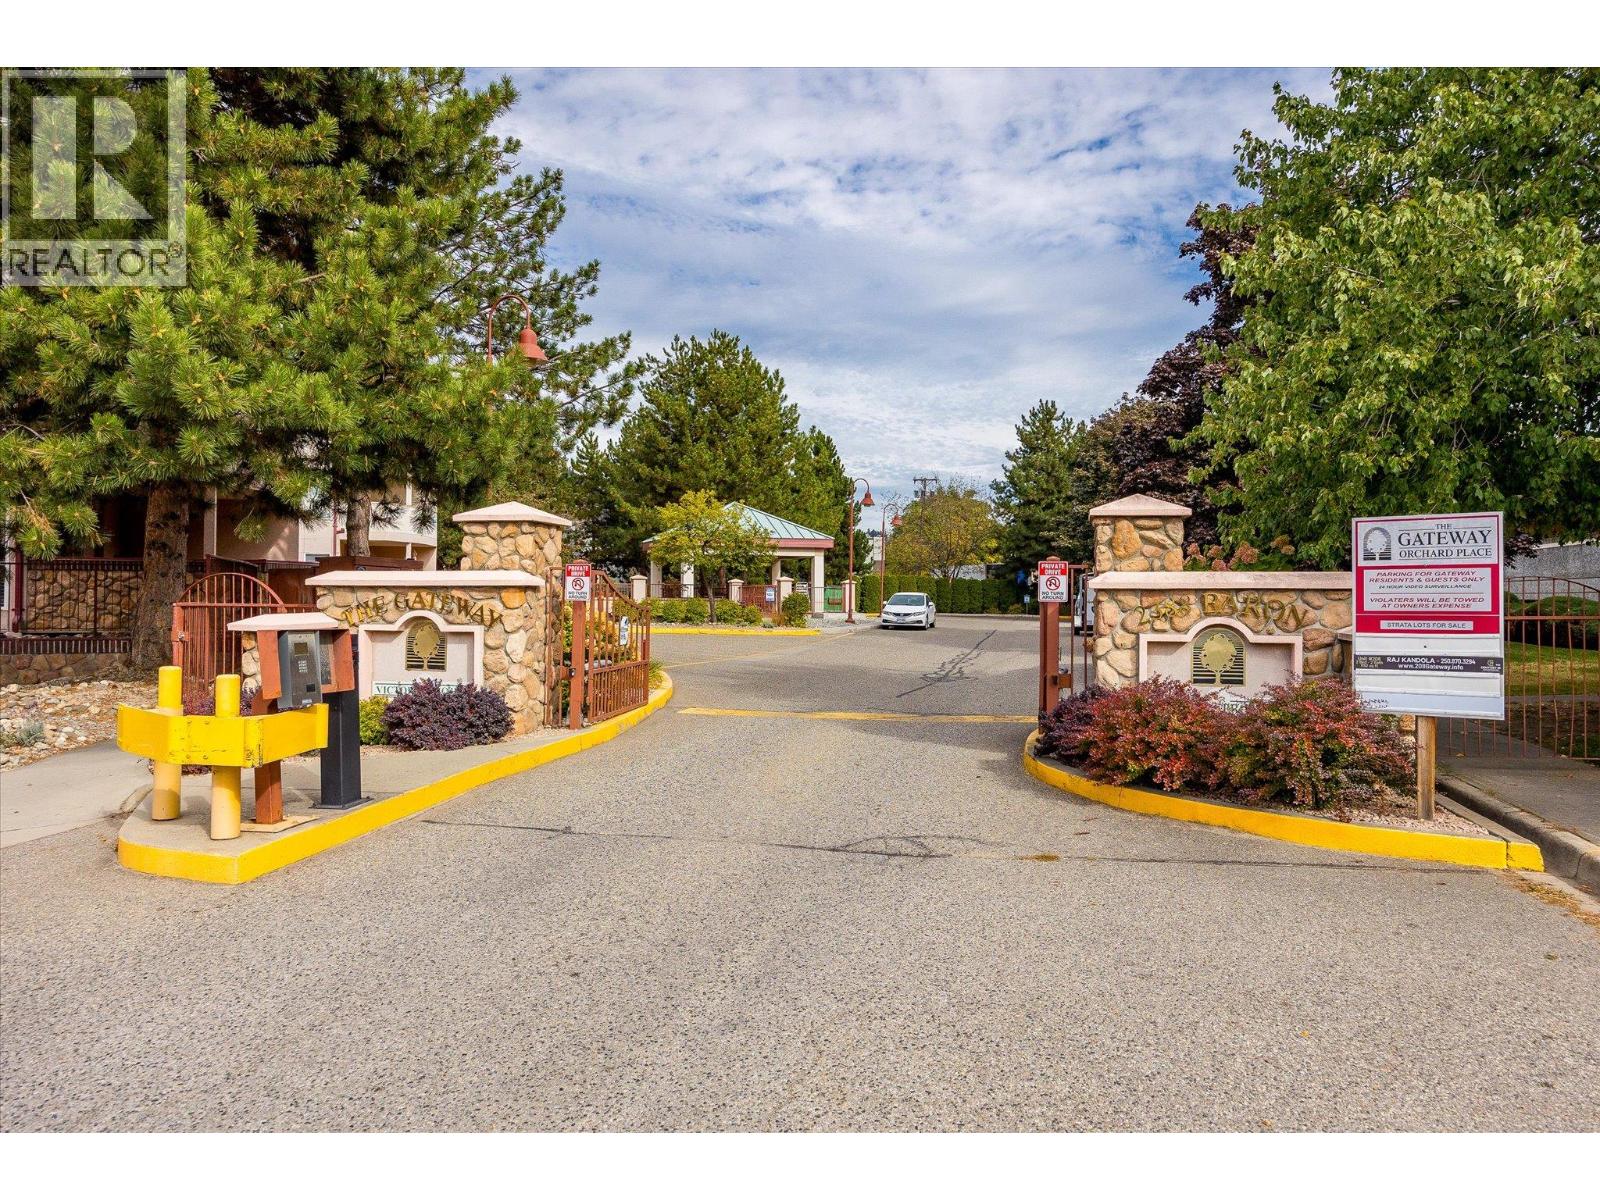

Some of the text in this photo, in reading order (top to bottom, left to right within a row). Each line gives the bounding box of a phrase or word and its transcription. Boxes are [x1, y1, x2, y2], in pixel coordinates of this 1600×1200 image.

[1398, 529, 1492, 546] GATEWAY
[1399, 547, 1492, 558] ORCHARD PLACE
[341, 590, 504, 628] THE GATEWAY
[1203, 593, 1308, 628] BARON
